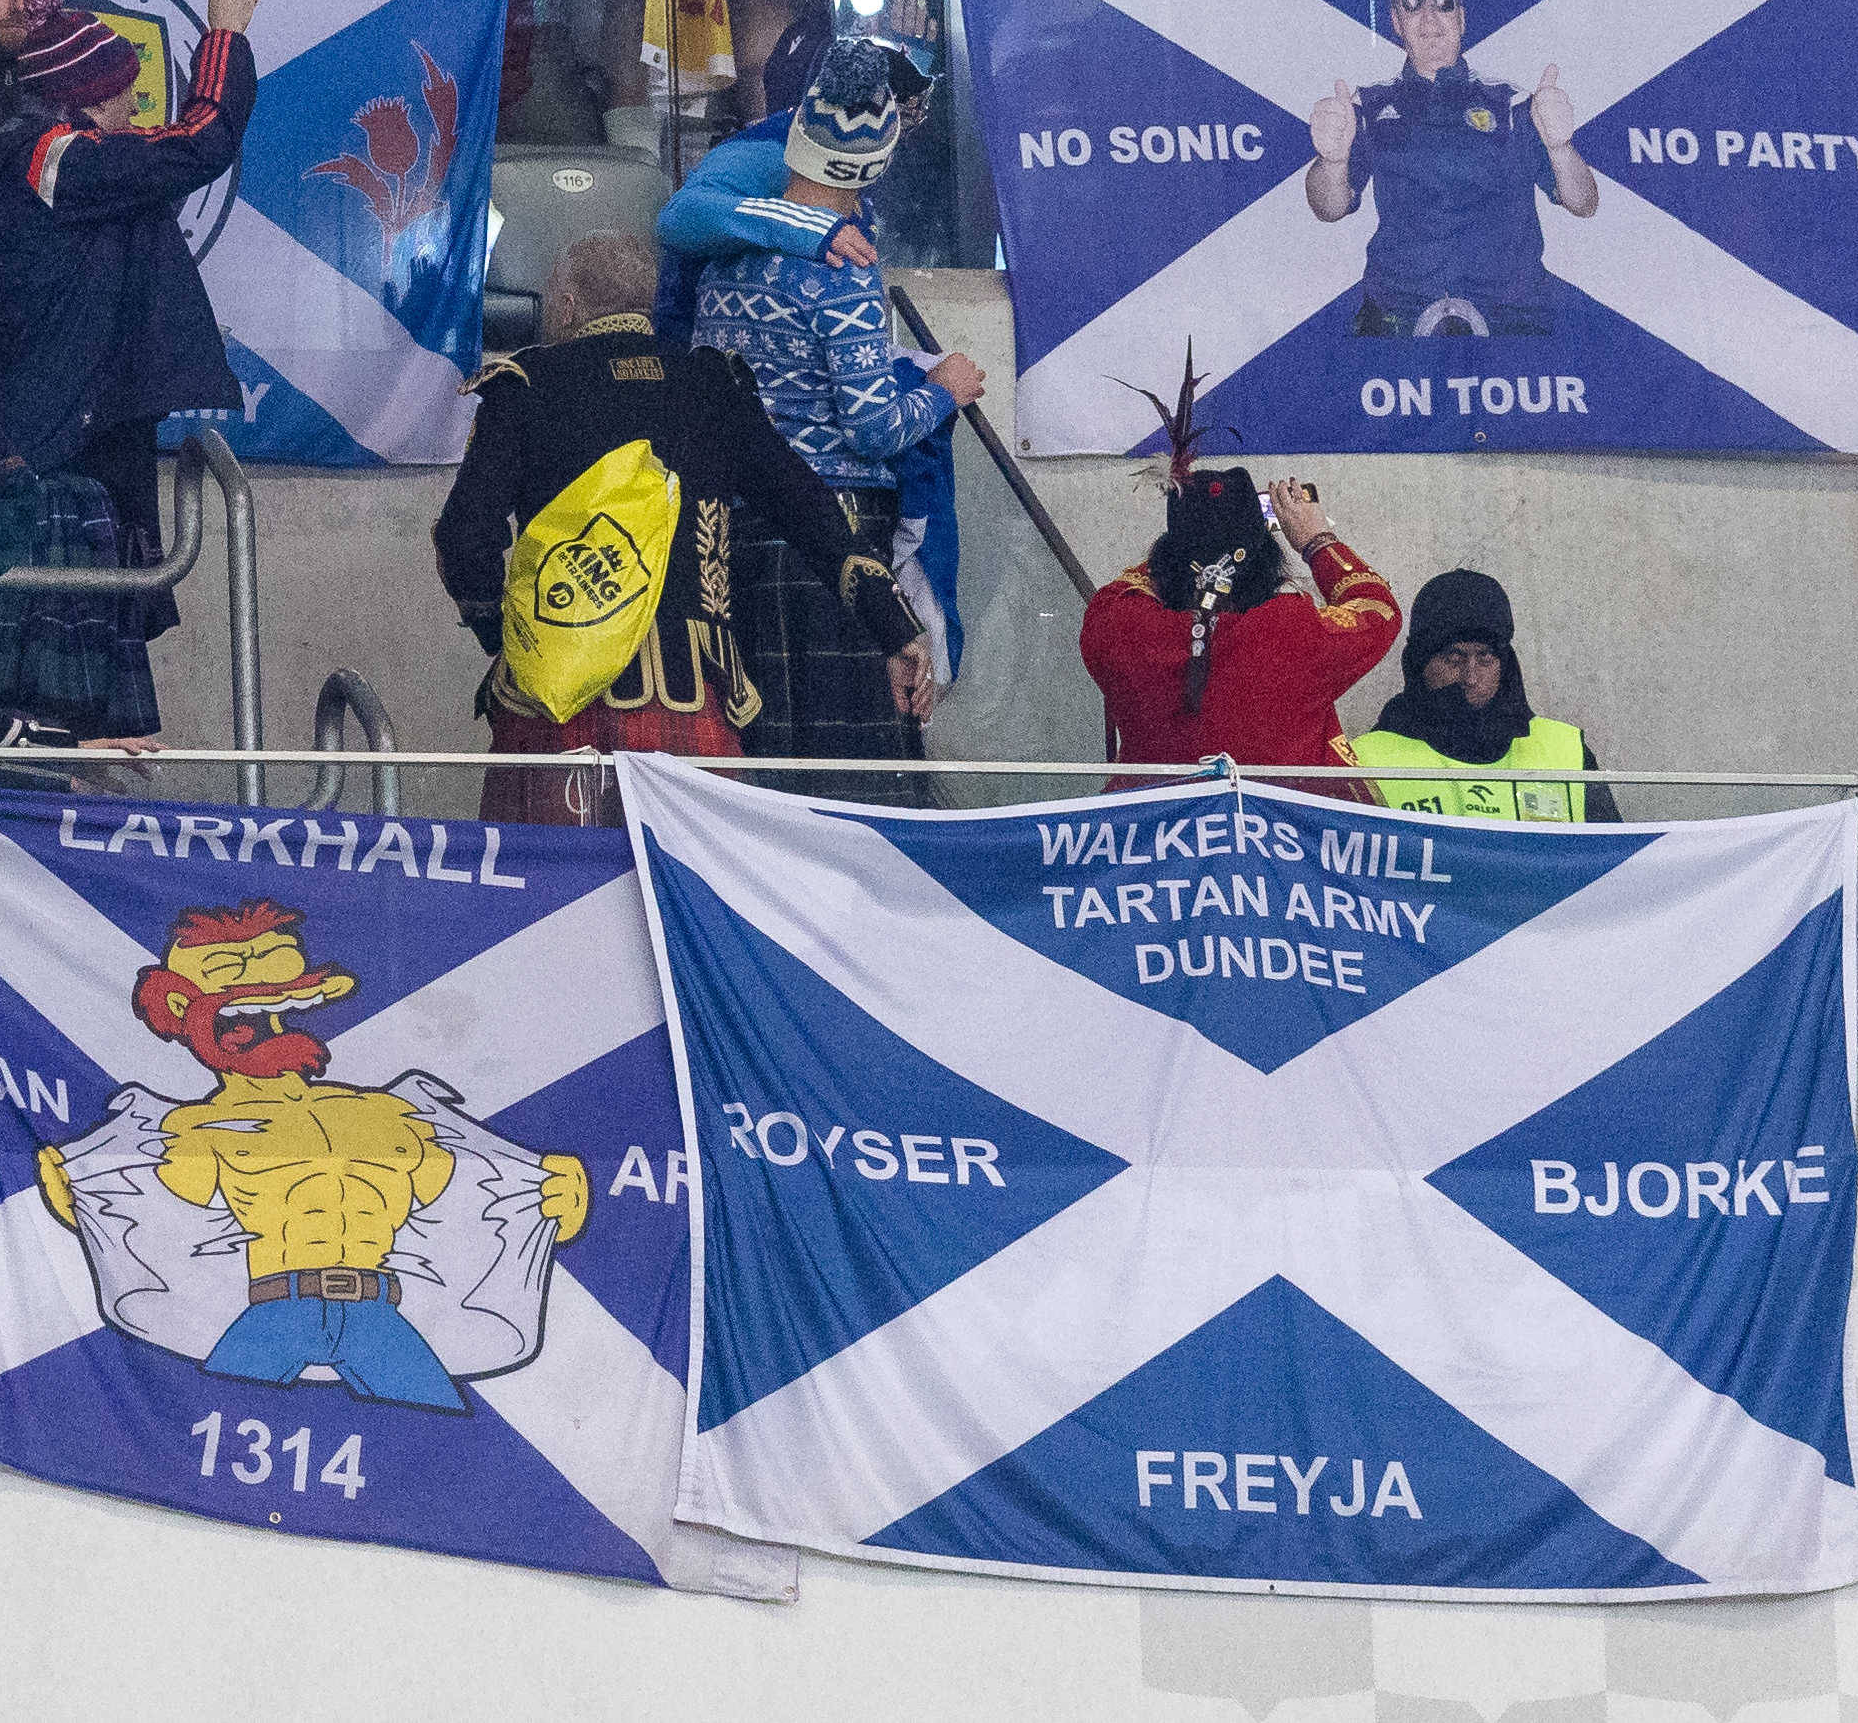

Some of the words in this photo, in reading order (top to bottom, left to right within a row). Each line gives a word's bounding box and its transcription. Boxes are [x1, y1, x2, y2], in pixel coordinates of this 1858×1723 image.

[1020, 129, 1094, 167] NO
[1110, 124, 1265, 162] SONIC
[1629, 128, 1697, 164] NO
[563, 175, 582, 188] 116
[1361, 378, 1432, 416] ON
[1447, 376, 1587, 415] TOUR
[566, 543, 622, 601] KING
[60, 809, 527, 889] LARKHALL
[1038, 814, 1304, 868] WALKERS
[1320, 826, 1452, 882] MILL
[1043, 875, 1272, 929] TARTAN
[1287, 885, 1435, 944] ARMY
[1136, 936, 1368, 994] DUNDEE
[723, 1102, 1006, 1187] ROYSER
[189, 1411, 366, 1499] 1314
[1136, 1451, 1423, 1521] FREYJA
